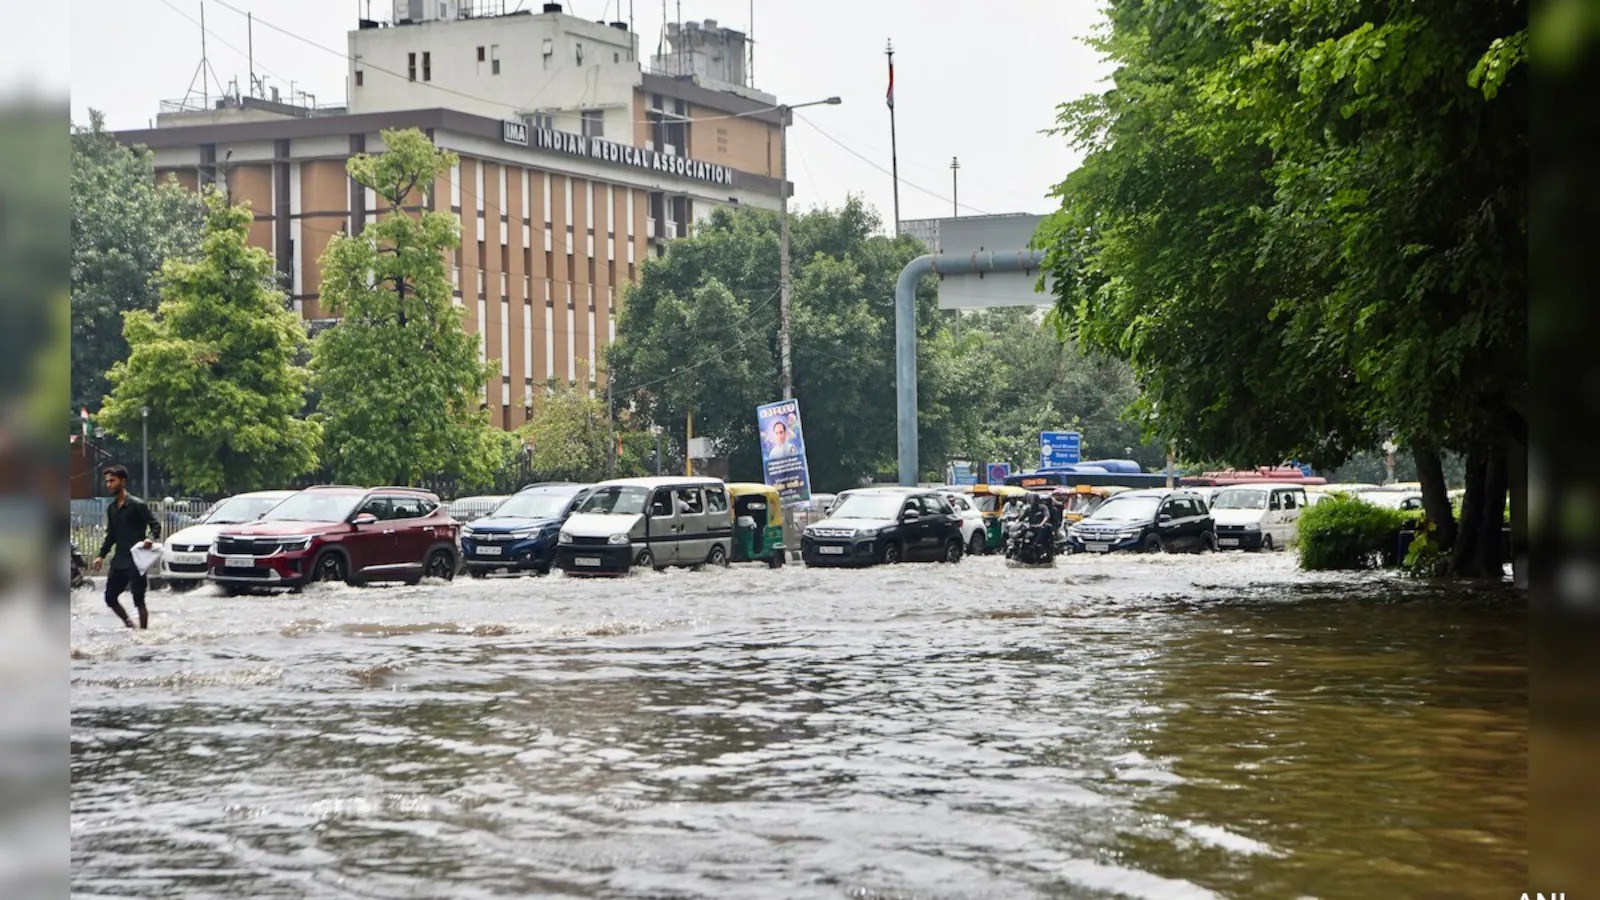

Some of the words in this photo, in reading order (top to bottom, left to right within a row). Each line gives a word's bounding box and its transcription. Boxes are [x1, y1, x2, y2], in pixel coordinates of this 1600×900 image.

[506, 123, 525, 141] IMA
[537, 128, 586, 155] INDIAN
[591, 139, 649, 168] MEDICAL
[652, 154, 732, 184] ASSOCIATION
